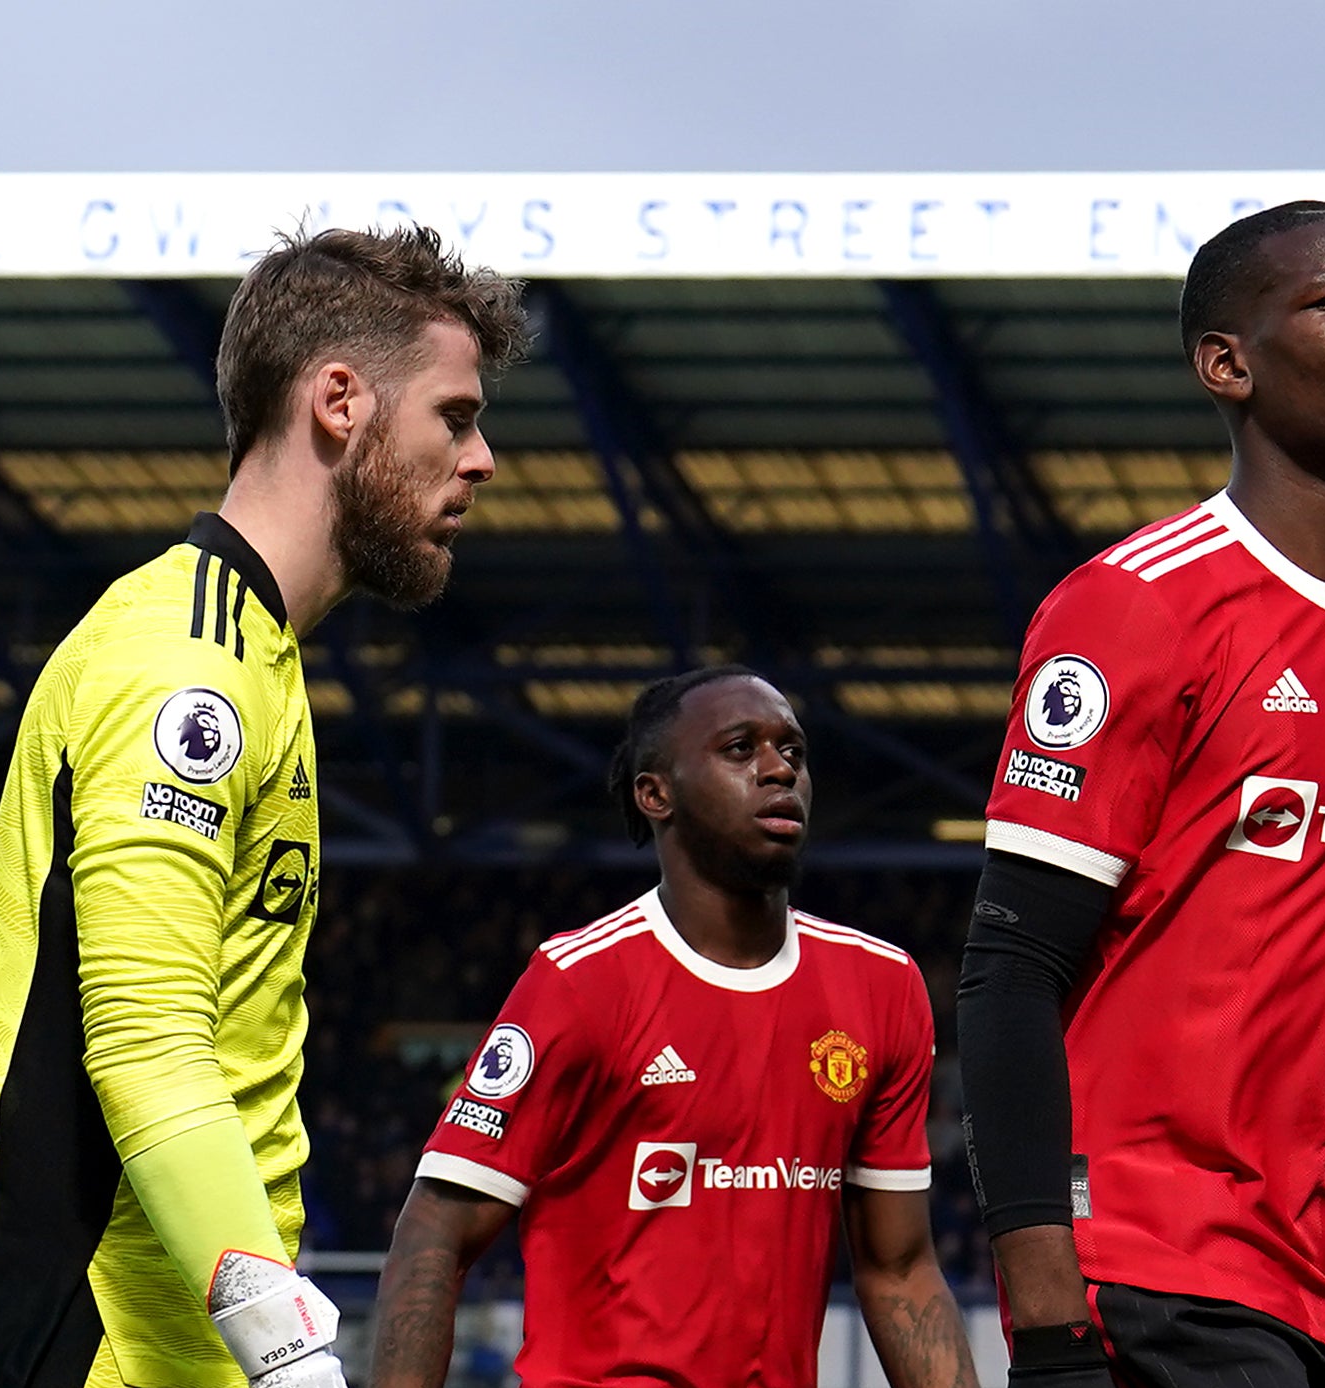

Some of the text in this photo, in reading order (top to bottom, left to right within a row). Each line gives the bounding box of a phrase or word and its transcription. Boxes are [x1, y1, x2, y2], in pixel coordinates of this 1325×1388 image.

[637, 199, 1010, 260] STREET
[1262, 695, 1318, 714] adidas
[1008, 748, 1076, 783] No room
[1021, 771, 1080, 802] racism
[143, 782, 217, 823] No room
[171, 806, 219, 840] racism
[640, 1069, 697, 1086] adidas
[461, 1100, 503, 1125] room
[260, 1338, 305, 1365] DE GEA
